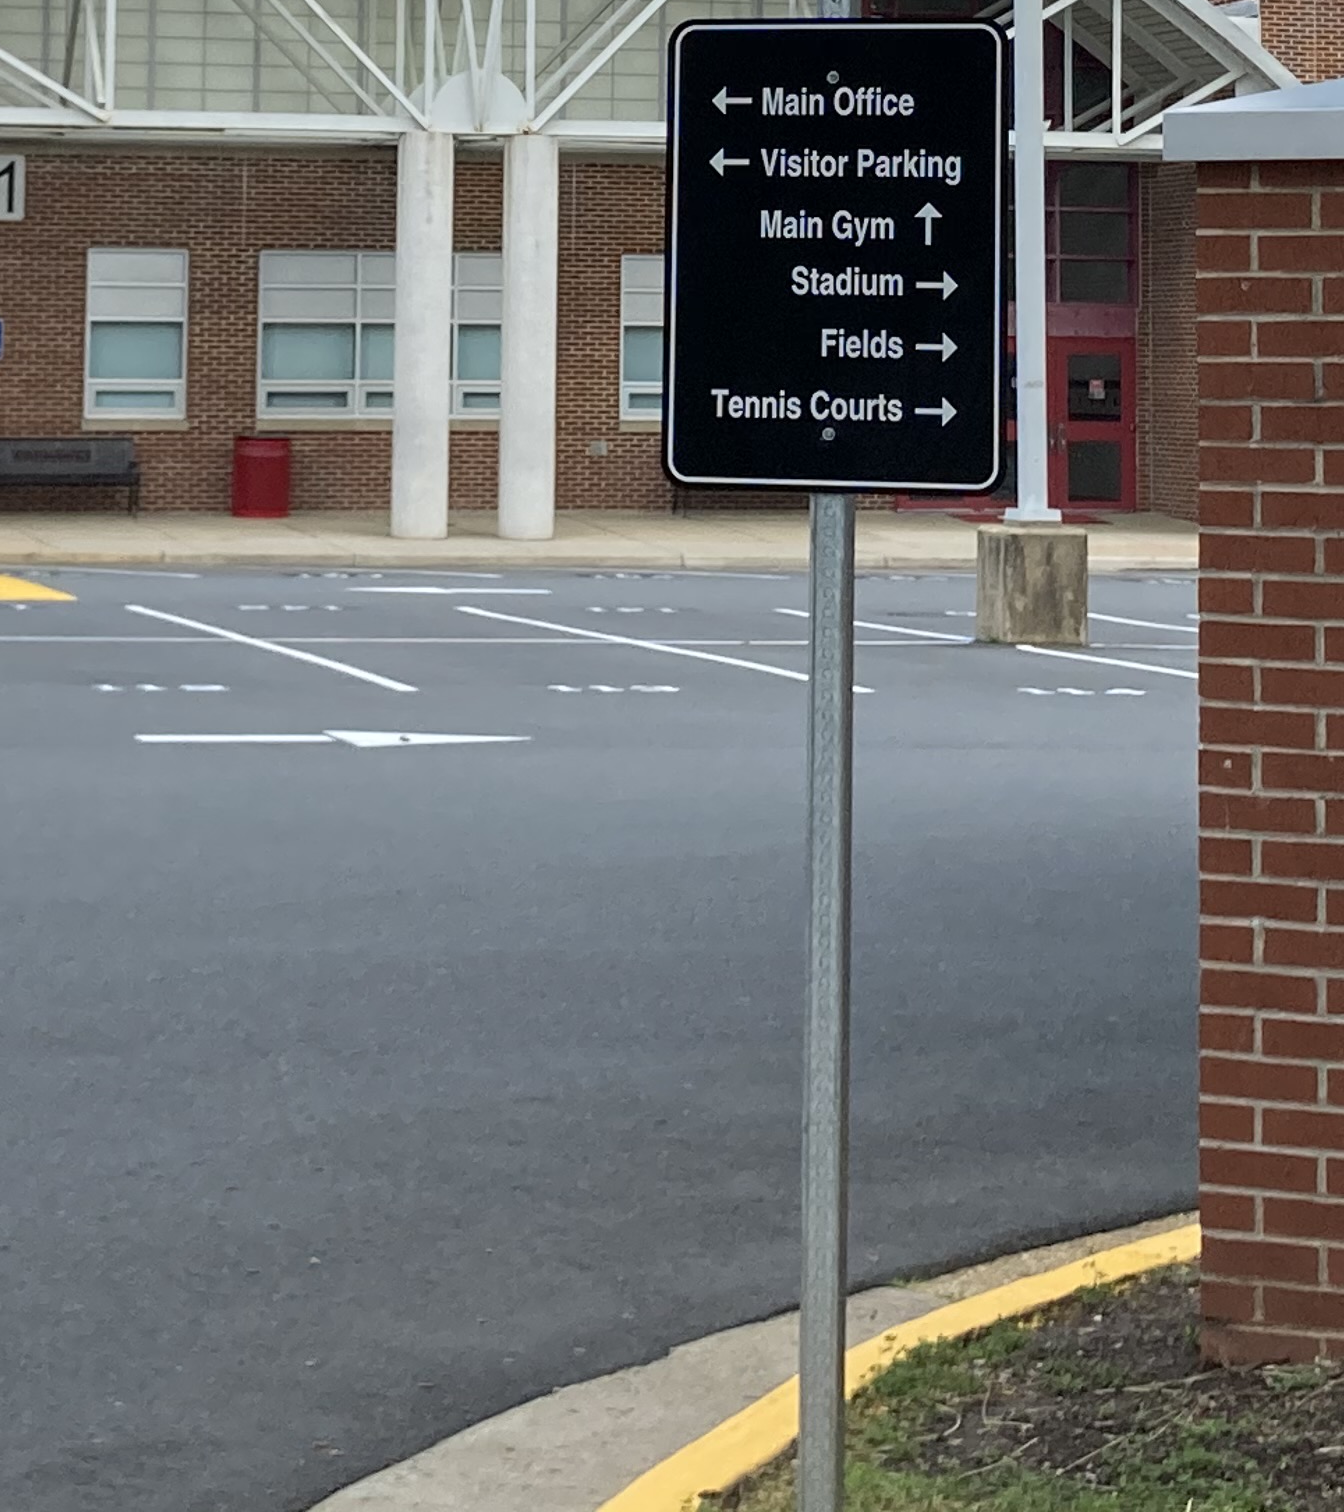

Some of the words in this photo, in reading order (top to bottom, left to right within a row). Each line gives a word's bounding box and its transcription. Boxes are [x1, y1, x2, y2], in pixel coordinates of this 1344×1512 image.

[762, 87, 824, 116] Main
[833, 86, 914, 117] Office
[761, 148, 848, 178] Visitor
[857, 149, 962, 186] Parking
[760, 210, 823, 239] Main
[832, 210, 895, 246] Gym
[791, 266, 904, 296] Stadium
[821, 329, 904, 359] Fields
[711, 389, 802, 420] Tennis
[809, 390, 903, 421] Courts
